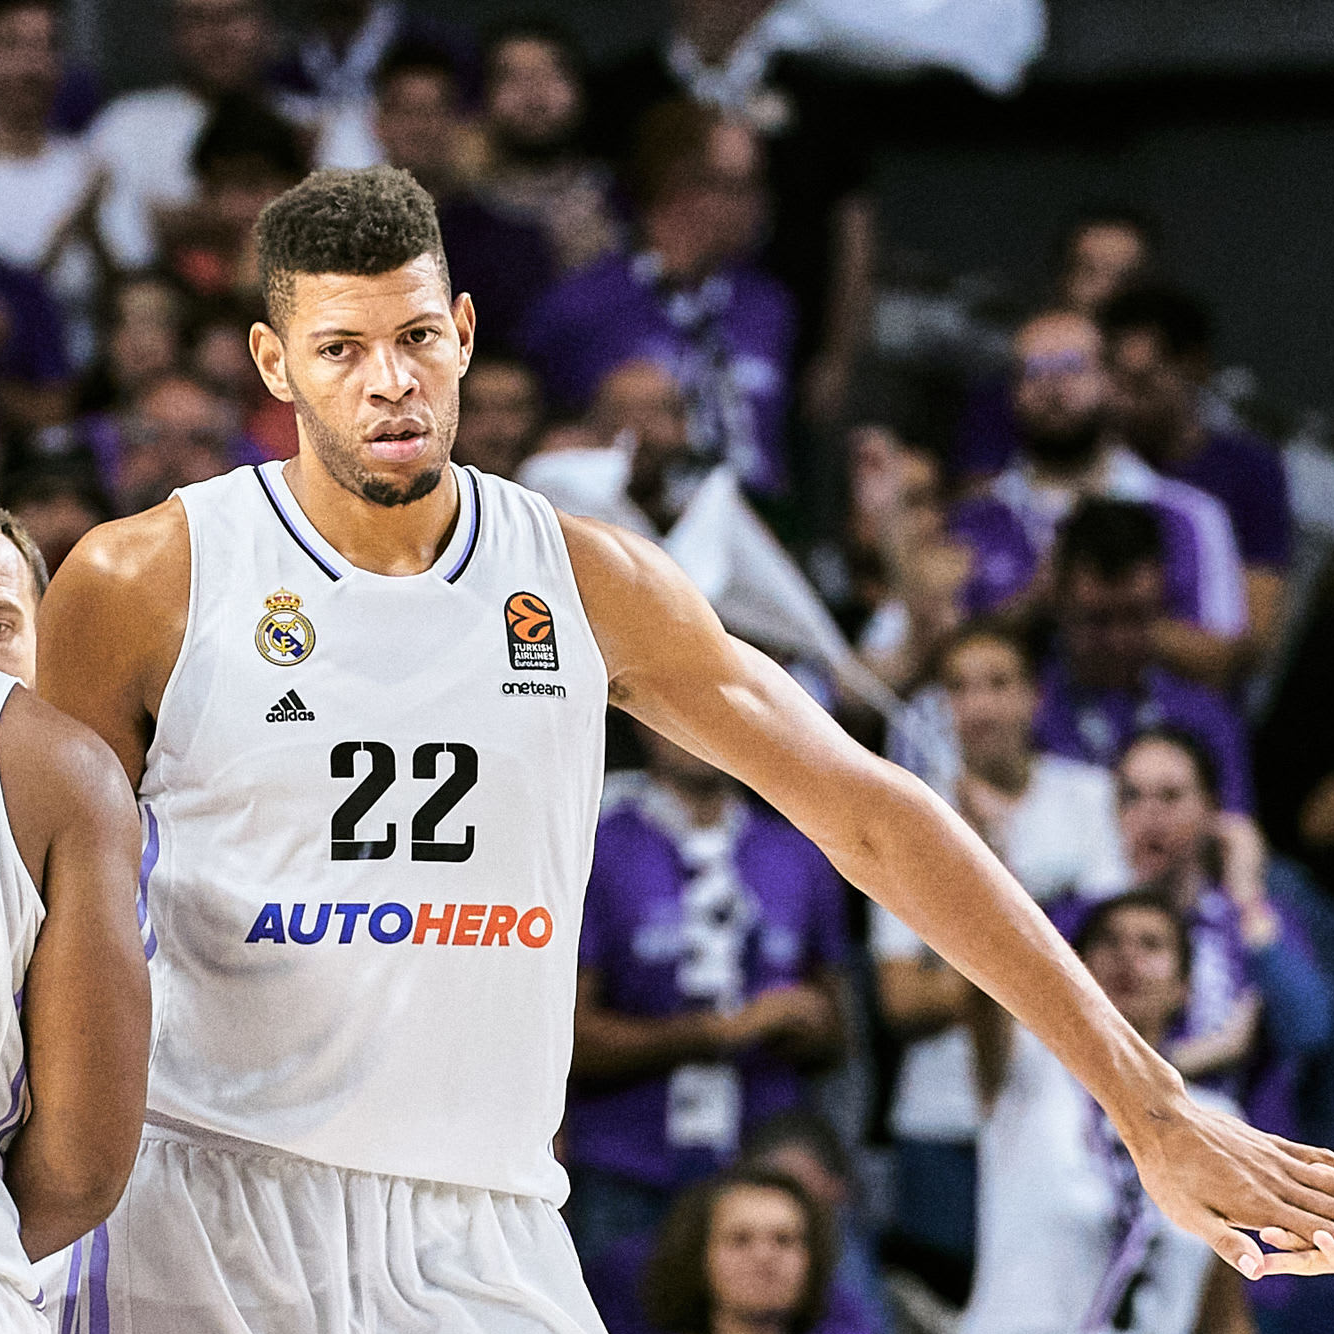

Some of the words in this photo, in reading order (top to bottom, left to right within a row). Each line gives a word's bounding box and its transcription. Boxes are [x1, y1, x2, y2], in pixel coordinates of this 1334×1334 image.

[513, 643, 553, 652] TURKISH
[514, 652, 555, 661] AIRLINES
[502, 681, 566, 698] oneteam
[265, 708, 316, 723] adidas
[330, 741, 478, 863] 22
[244, 902, 554, 949] AUTOHERO
